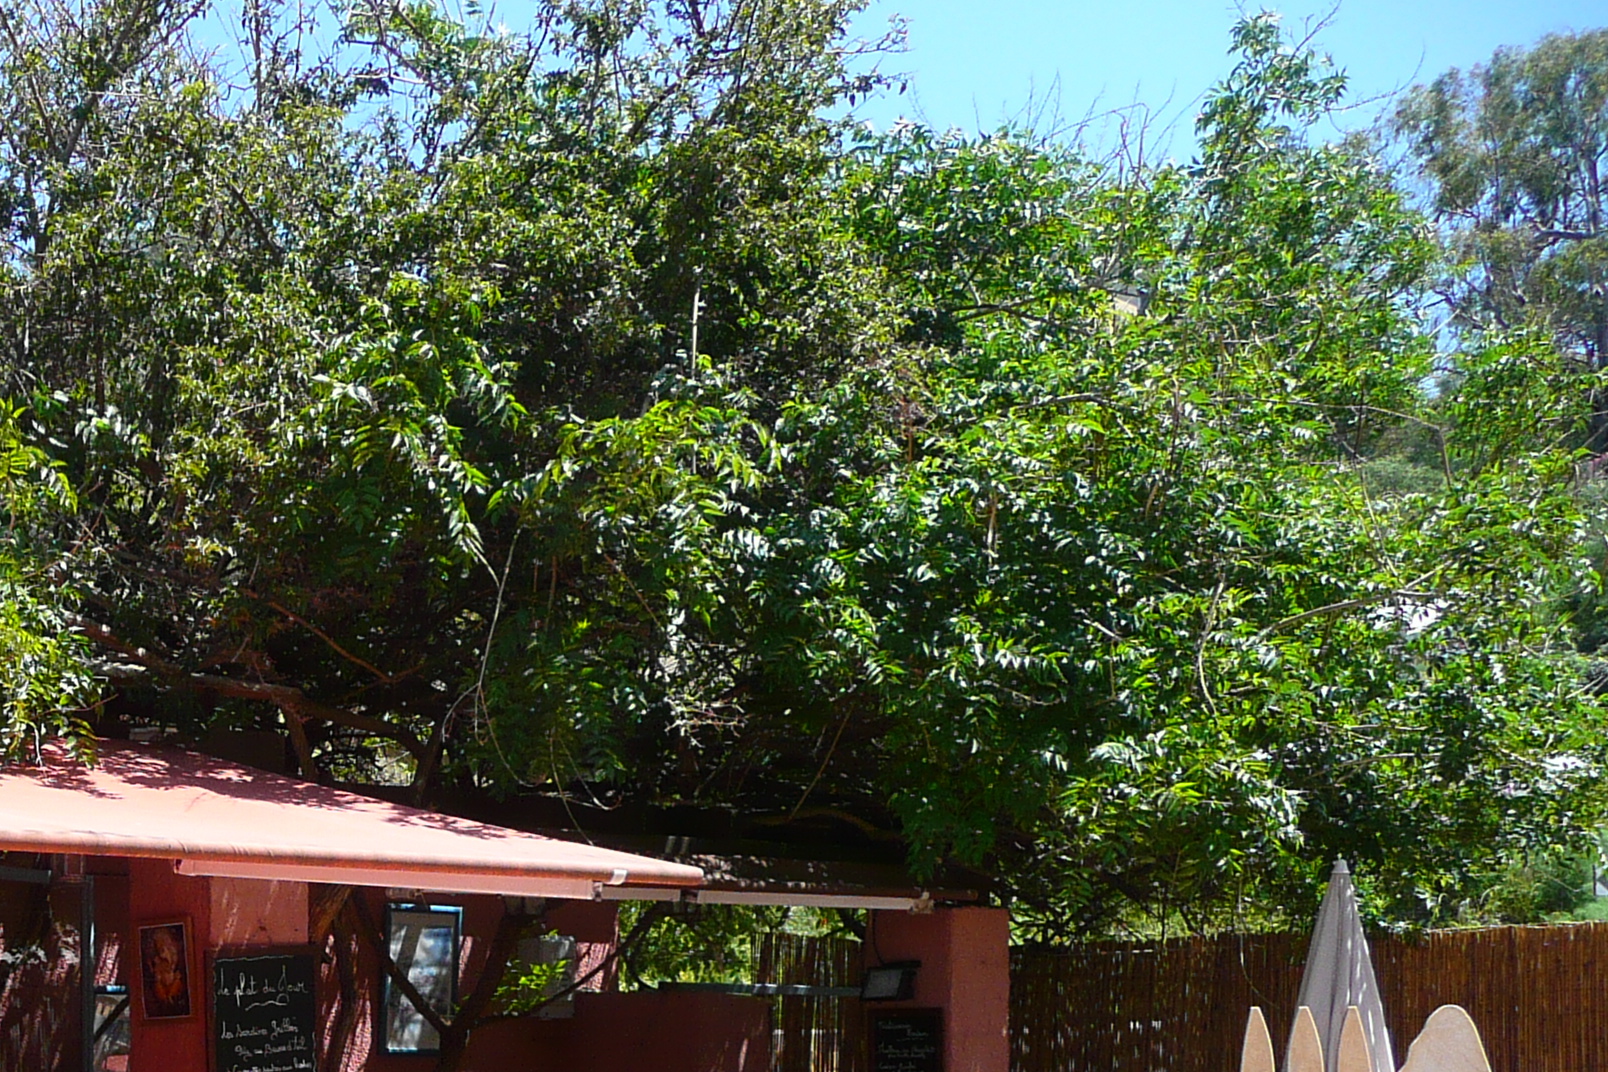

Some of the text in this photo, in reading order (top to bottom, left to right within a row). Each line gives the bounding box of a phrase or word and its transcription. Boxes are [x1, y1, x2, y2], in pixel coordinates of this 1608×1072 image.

[217, 966, 231, 996] Le
[233, 972, 258, 1008] plat
[262, 978, 277, 994] du
